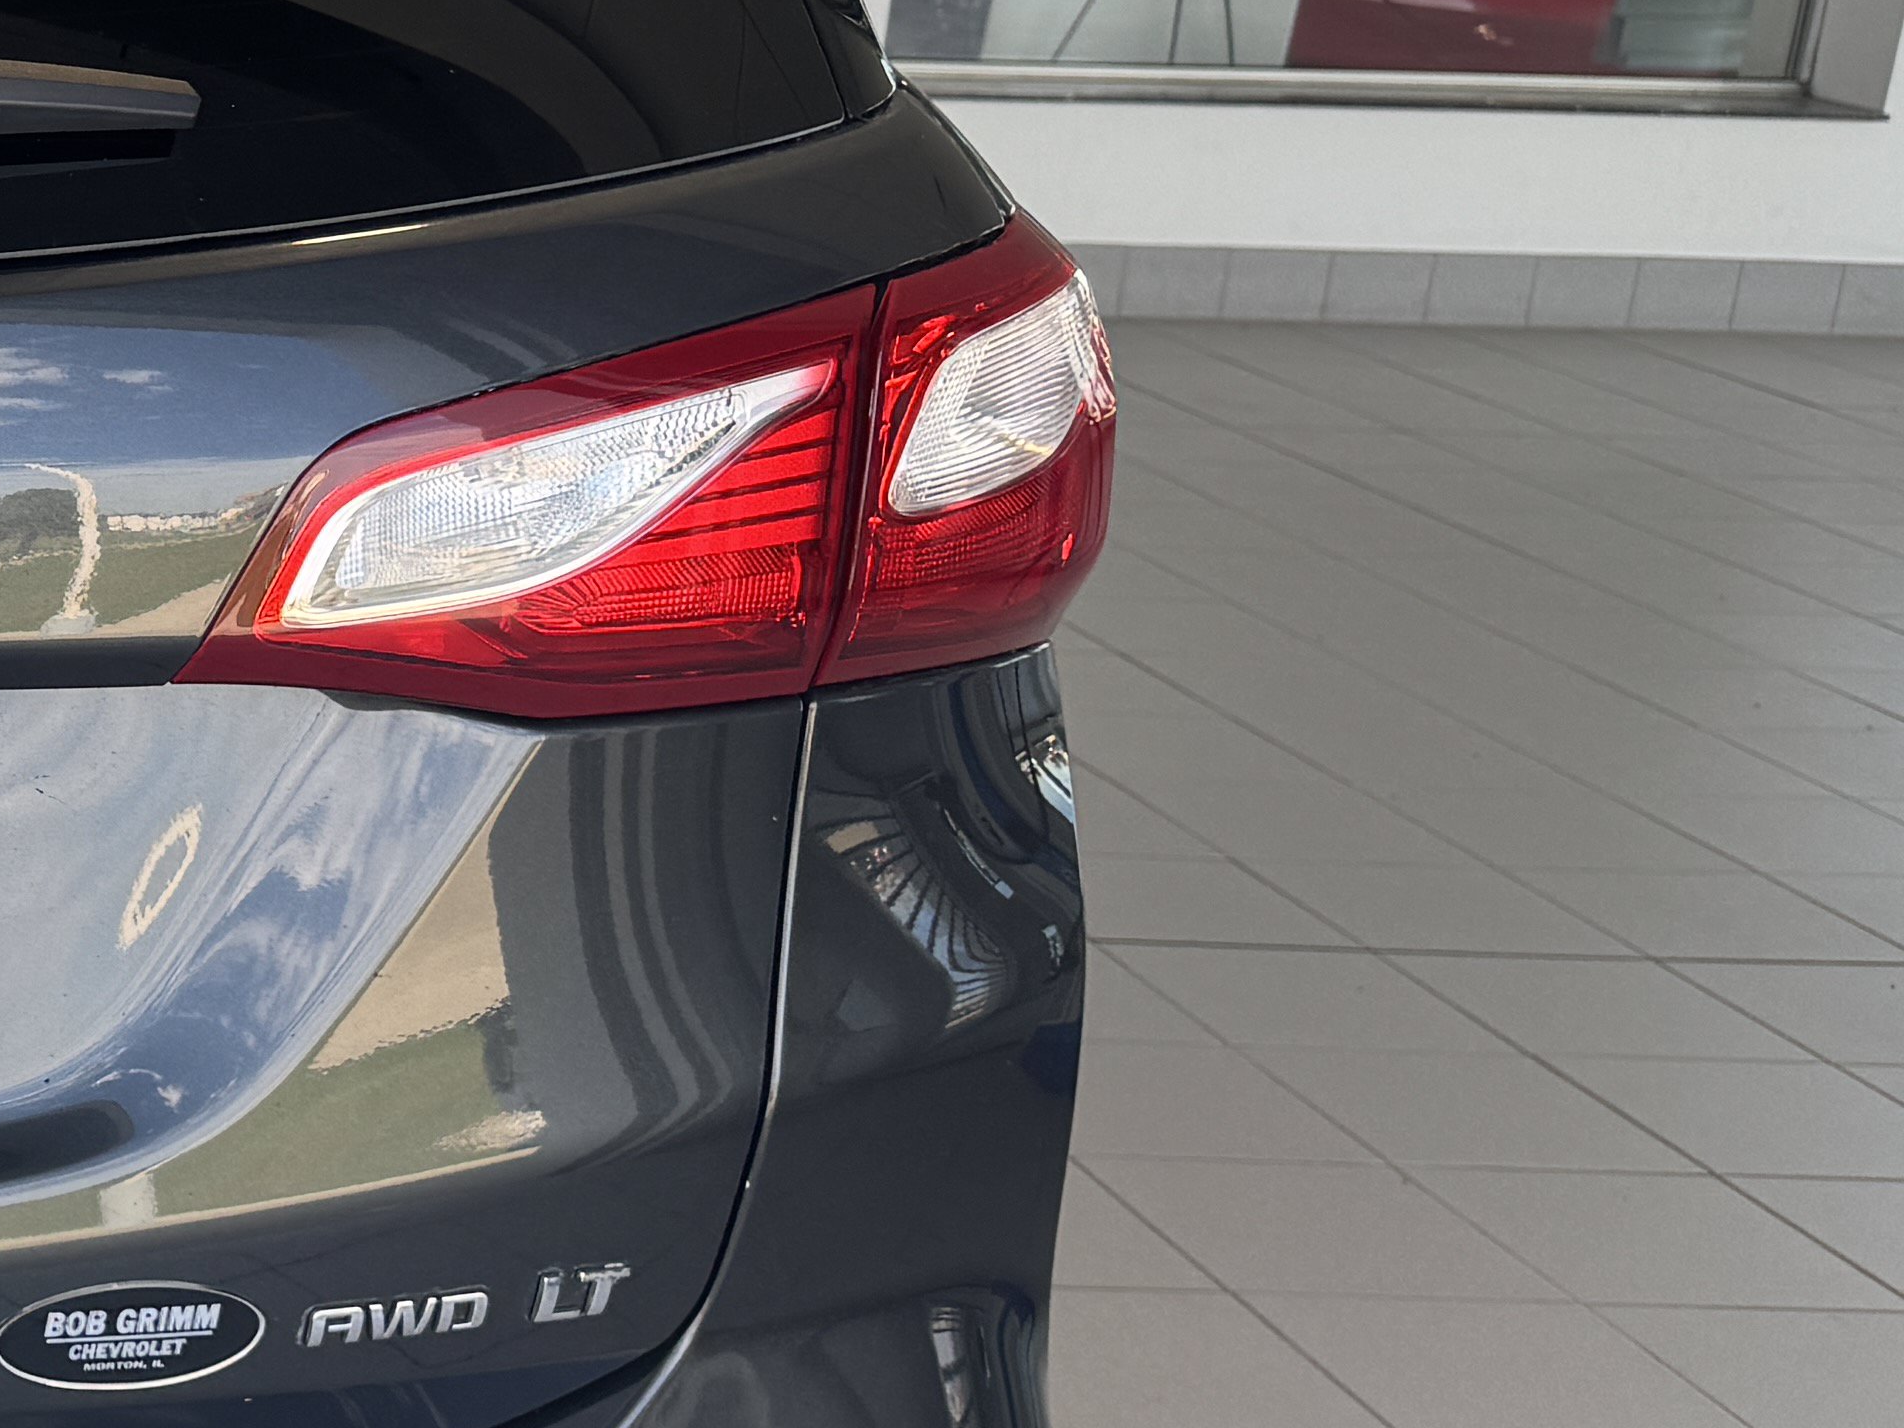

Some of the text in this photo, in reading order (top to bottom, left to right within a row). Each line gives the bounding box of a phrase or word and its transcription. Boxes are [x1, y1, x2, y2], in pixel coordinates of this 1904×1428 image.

[43, 1303, 222, 1338] BOB GRIMM
[301, 1263, 631, 1348] AWD LT
[68, 1338, 188, 1361] CHEVROLET
